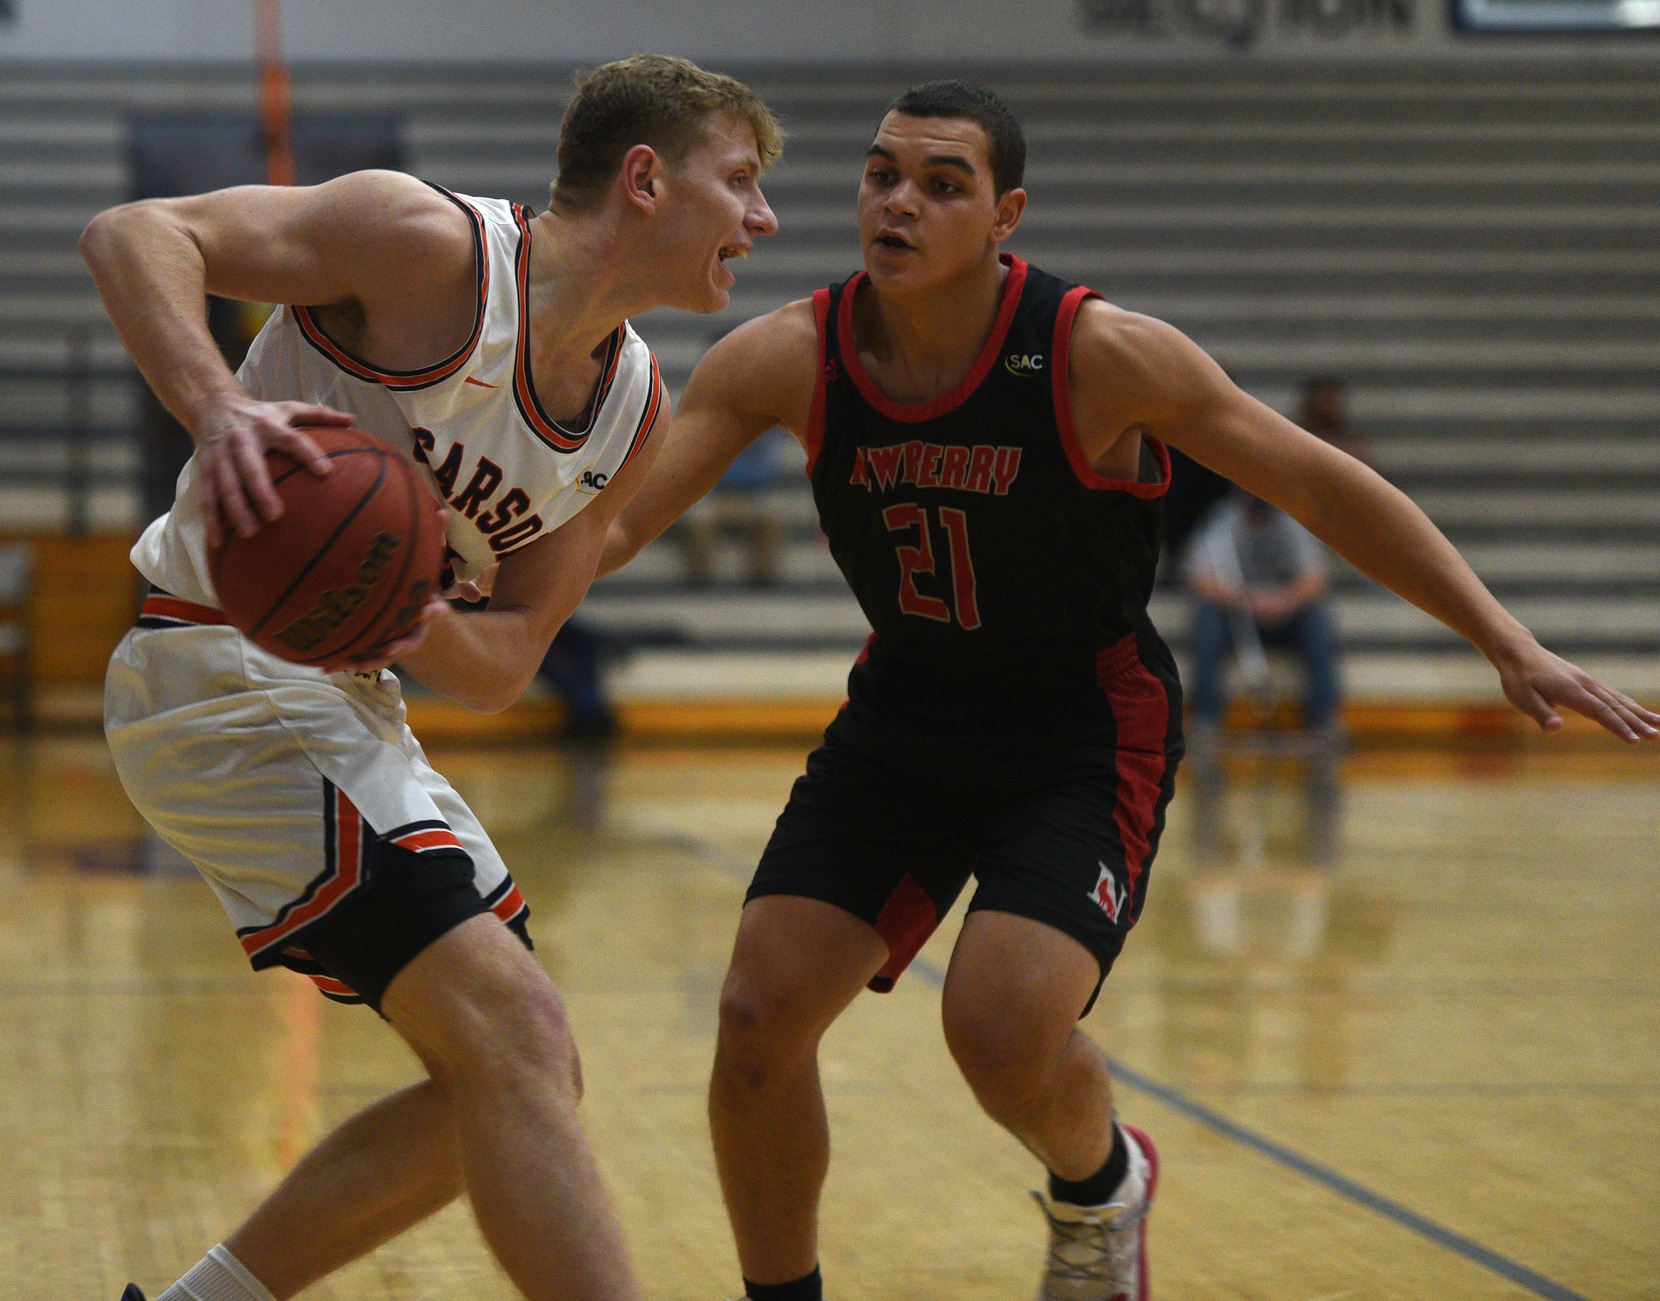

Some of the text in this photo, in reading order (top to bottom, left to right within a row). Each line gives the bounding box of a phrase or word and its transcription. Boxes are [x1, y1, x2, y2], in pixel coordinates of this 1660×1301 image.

[1010, 354, 1043, 369] SAC
[412, 426, 550, 563] CARSO
[581, 471, 608, 490] AC
[882, 503, 981, 630] 21
